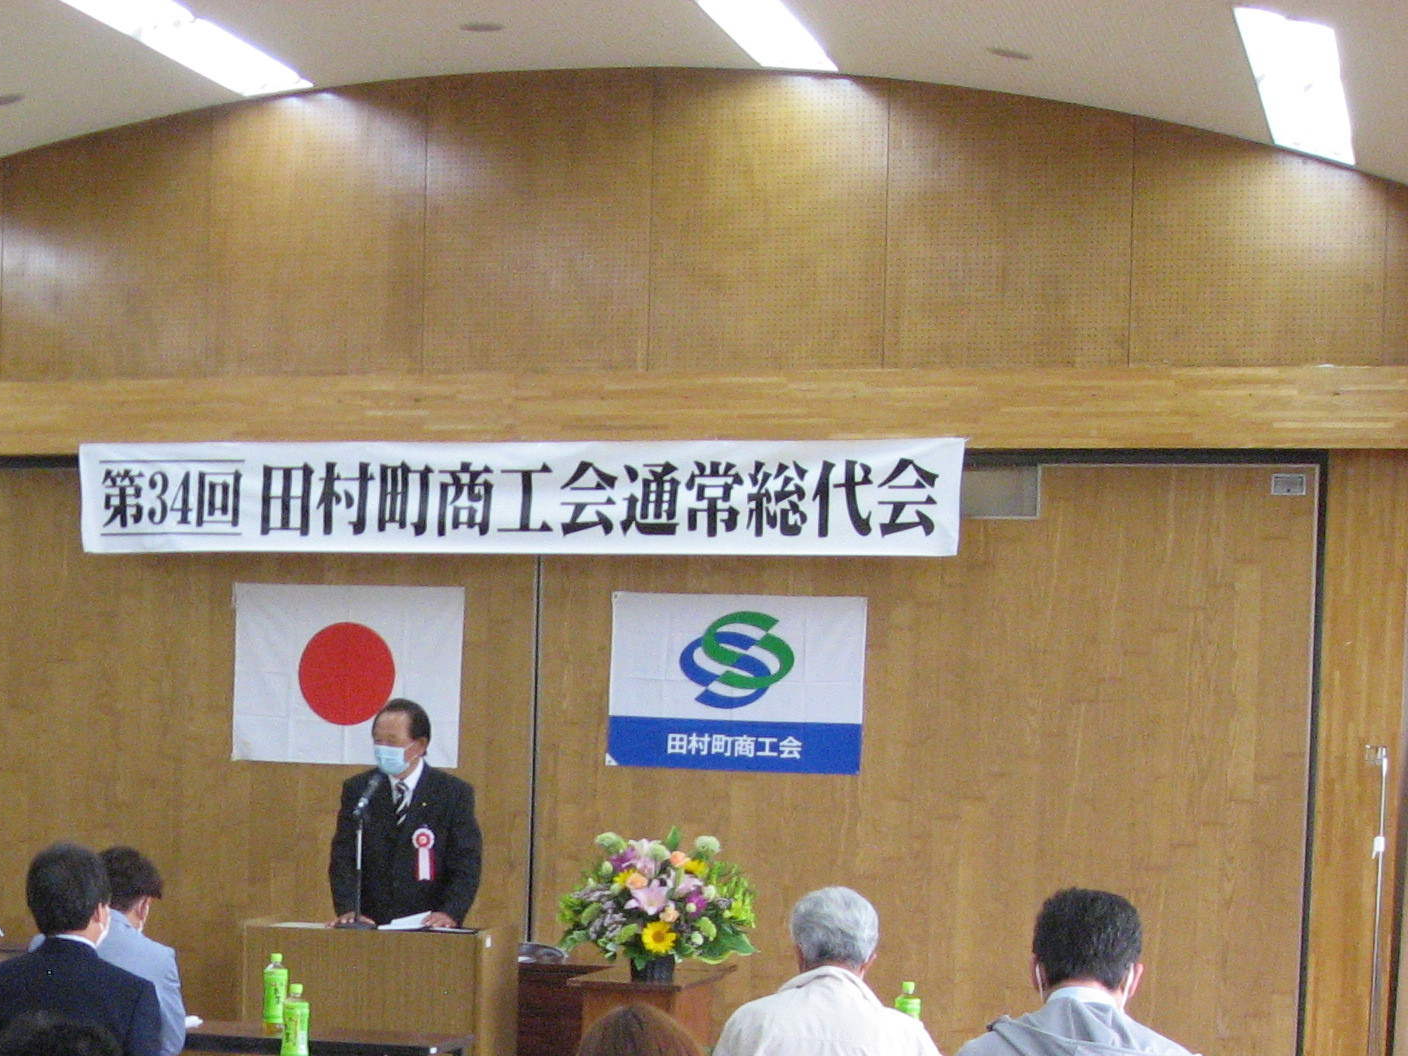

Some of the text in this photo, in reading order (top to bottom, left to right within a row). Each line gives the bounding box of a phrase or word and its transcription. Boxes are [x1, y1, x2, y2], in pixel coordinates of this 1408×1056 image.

[102, 458, 939, 539] 第34回 田村町商工会通常総代会
[667, 732, 803, 759] 田村町商工会
